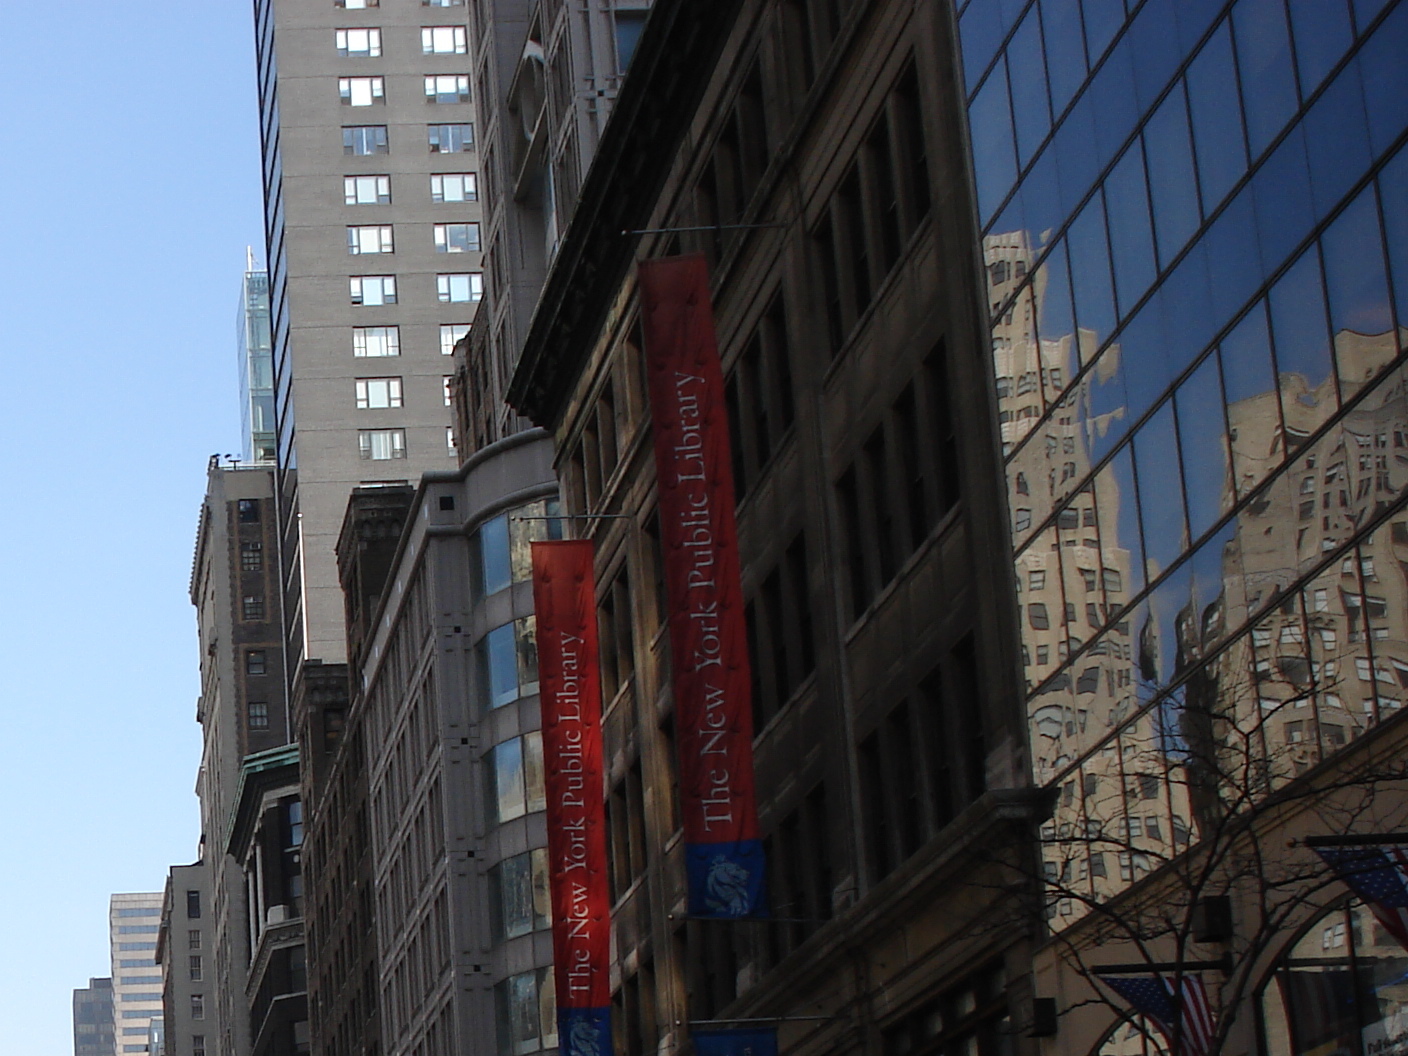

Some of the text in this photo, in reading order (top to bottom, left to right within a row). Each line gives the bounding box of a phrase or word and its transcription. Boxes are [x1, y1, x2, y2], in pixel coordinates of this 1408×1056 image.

[674, 370, 733, 833] The New York Public Library
[557, 631, 592, 999] The New York Public Library
